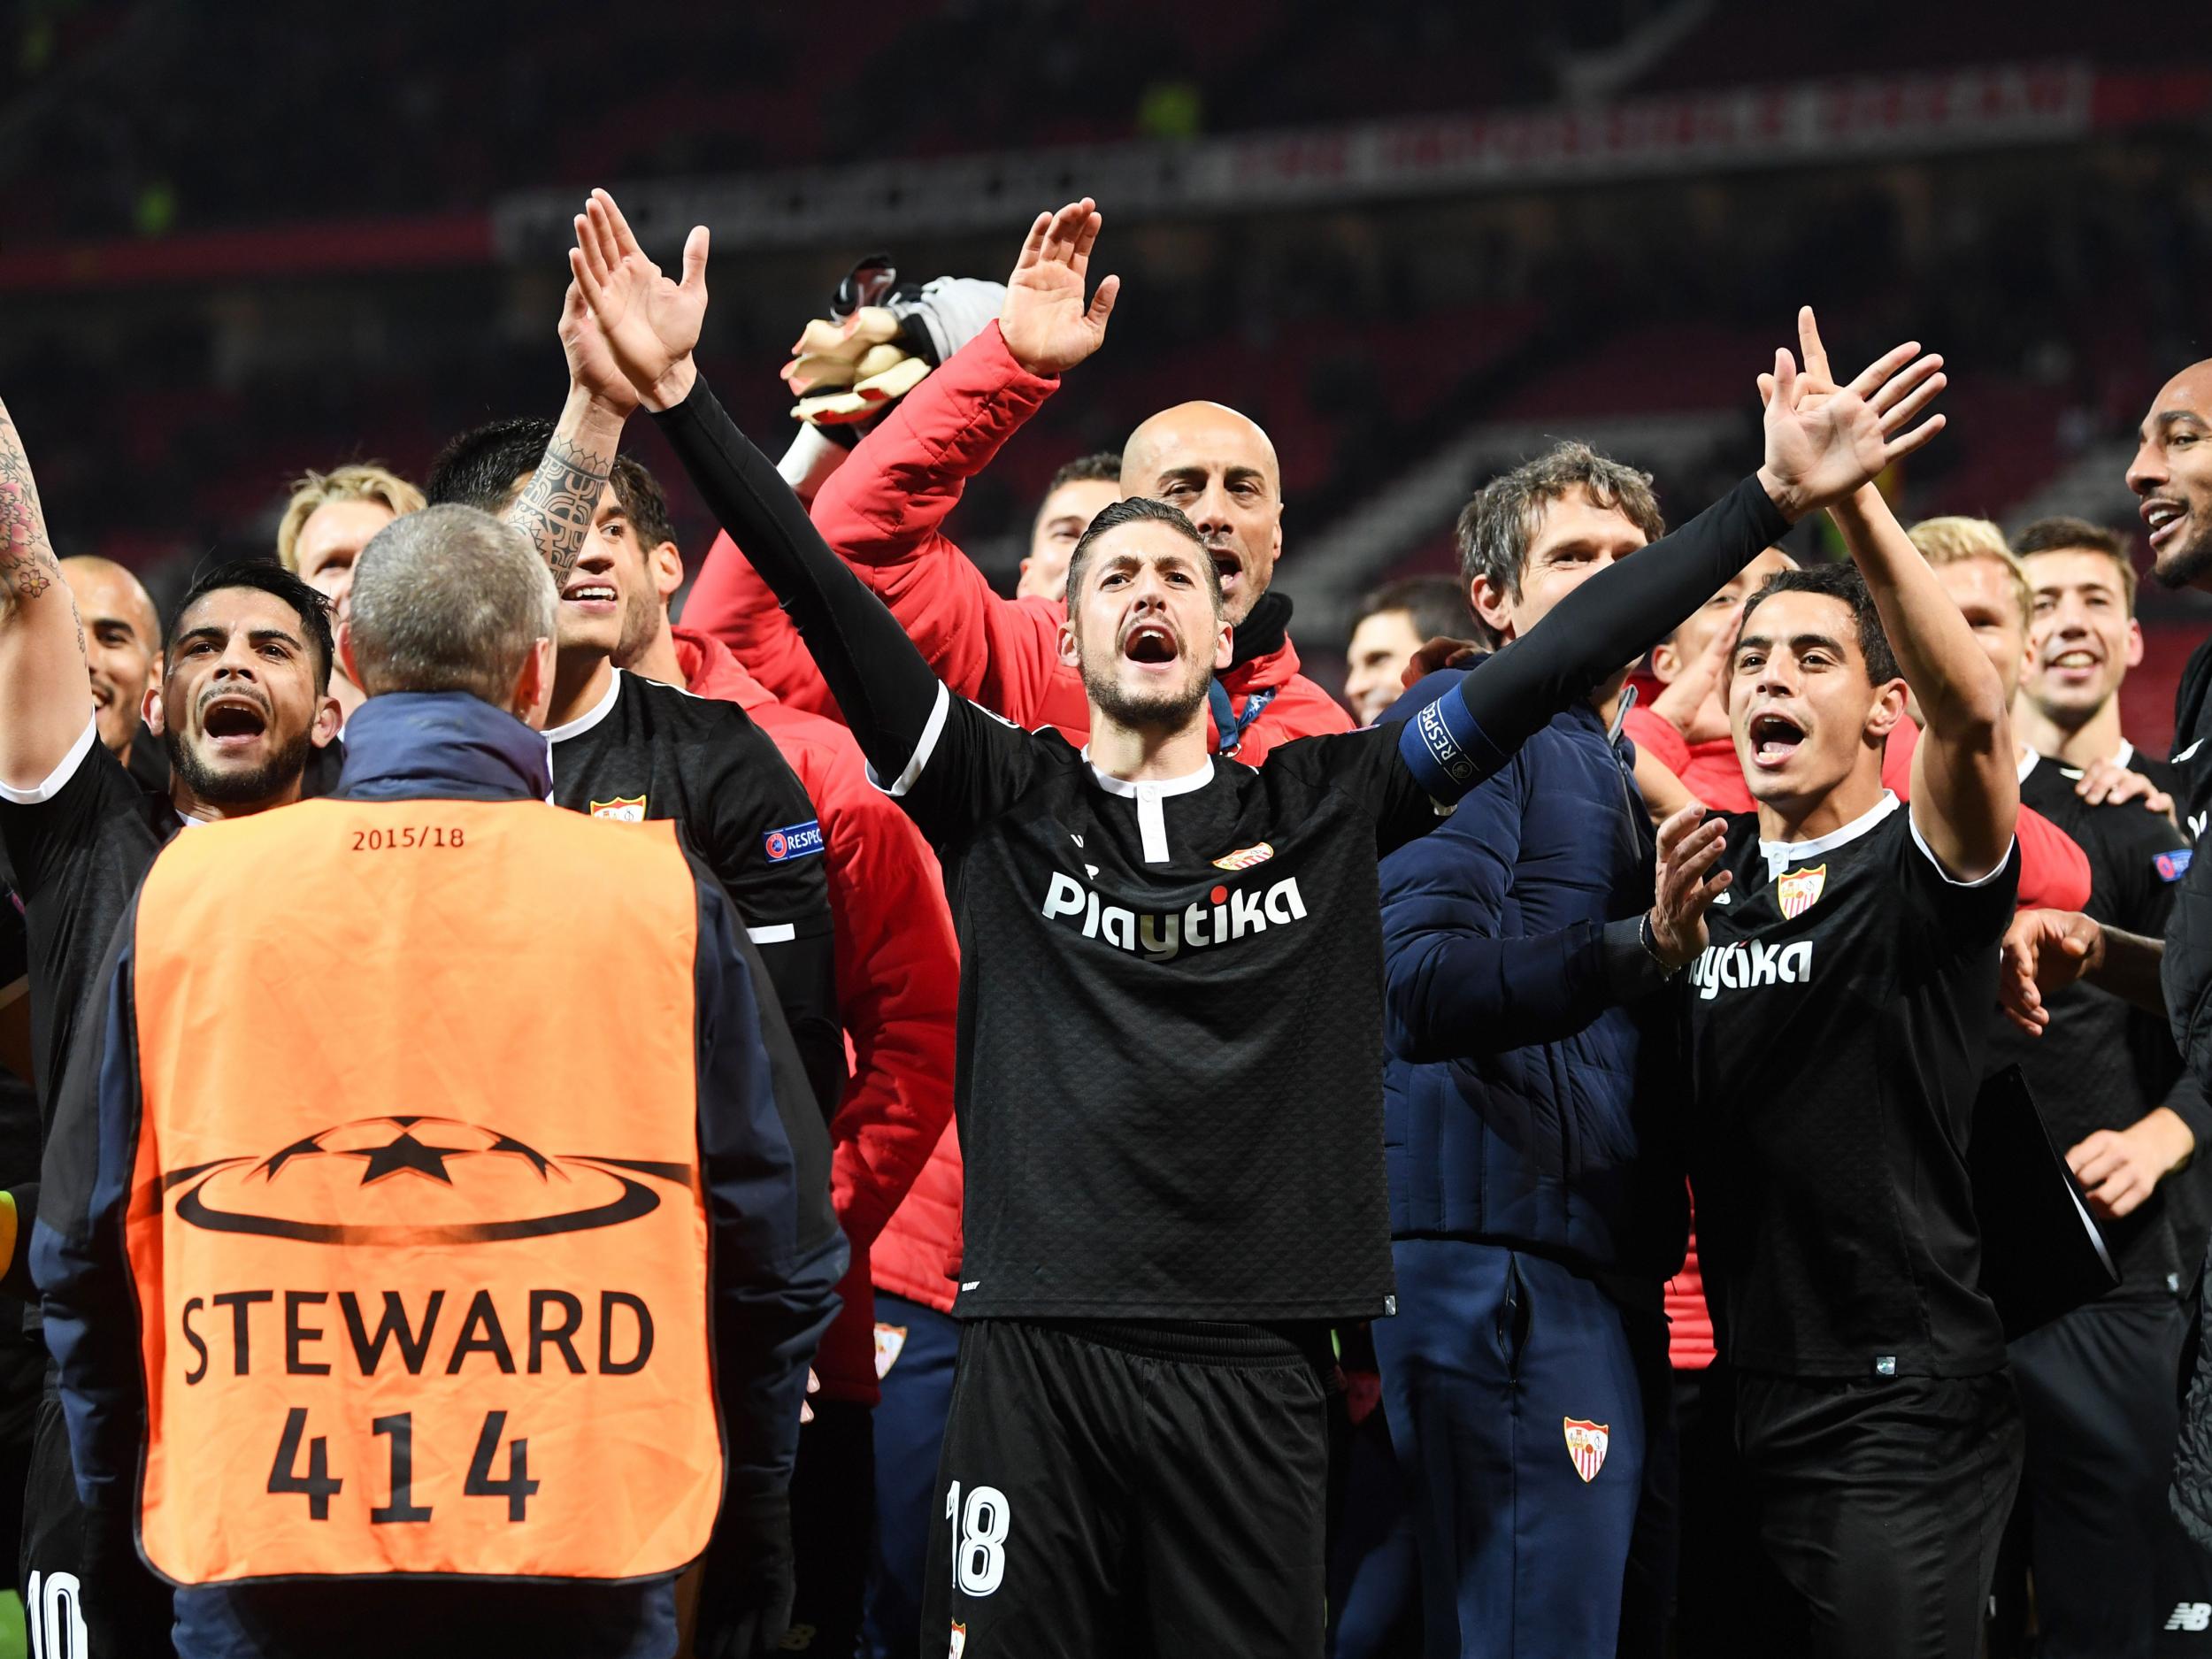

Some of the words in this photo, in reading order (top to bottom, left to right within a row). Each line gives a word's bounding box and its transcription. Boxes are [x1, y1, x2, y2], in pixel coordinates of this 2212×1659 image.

[351, 826, 465, 851] 2015/18
[1041, 871, 1308, 962] Playtika
[181, 1289, 655, 1386] STEWARD
[266, 1407, 541, 1525] 414
[945, 1479, 1010, 1597] 18
[27, 1570, 88, 1659] 10
